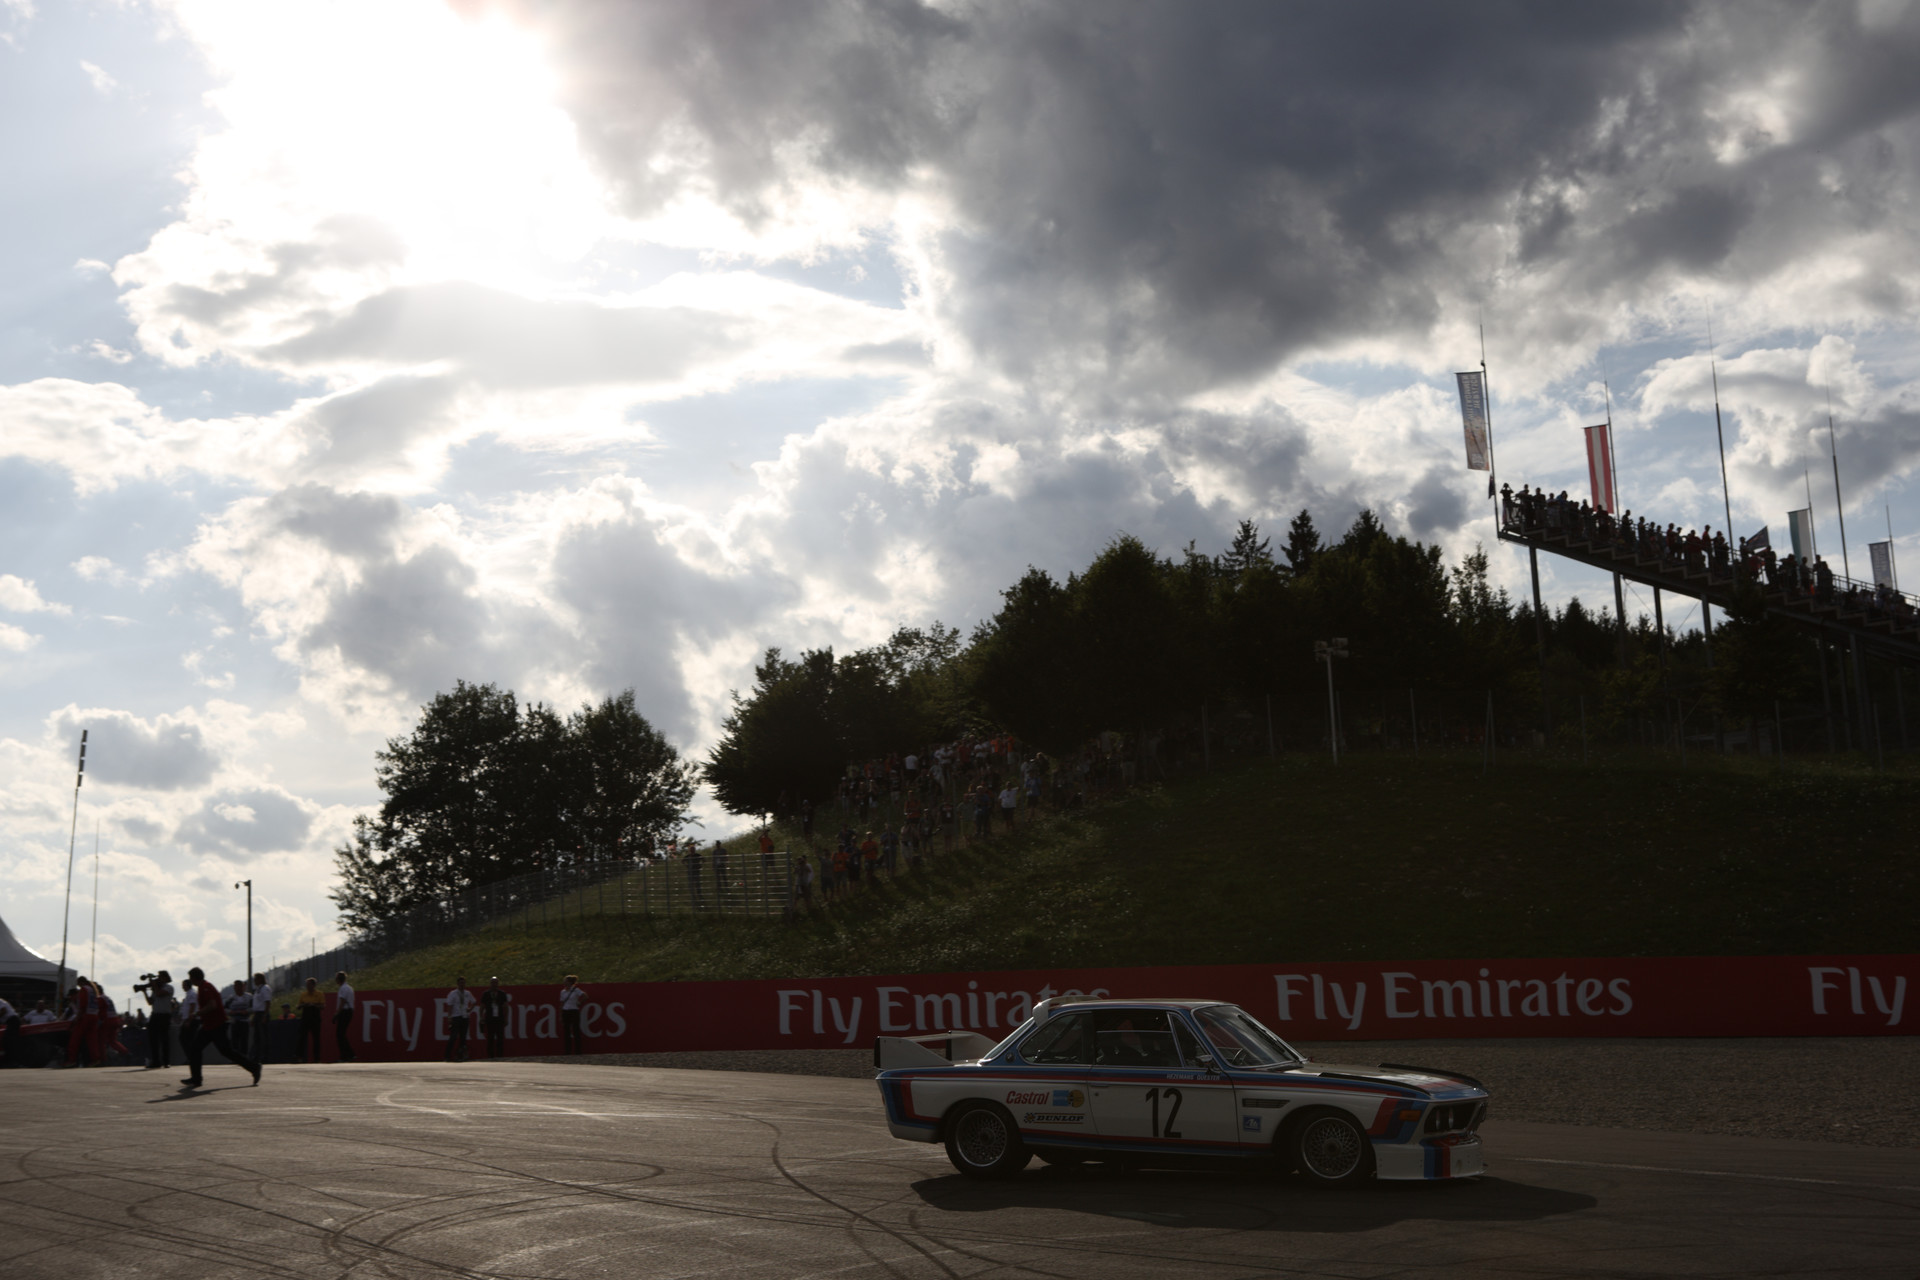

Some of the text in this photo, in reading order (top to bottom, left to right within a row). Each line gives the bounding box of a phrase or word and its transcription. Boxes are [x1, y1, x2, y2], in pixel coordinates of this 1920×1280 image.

[777, 980, 1110, 1044] Fly Emira
[1273, 967, 1634, 1031] Fly Emirates
[1807, 966, 1907, 1026] Fly
[362, 999, 423, 1051] Fly
[1006, 1090, 1050, 1105] Castrol
[1145, 1087, 1182, 1139] 12
